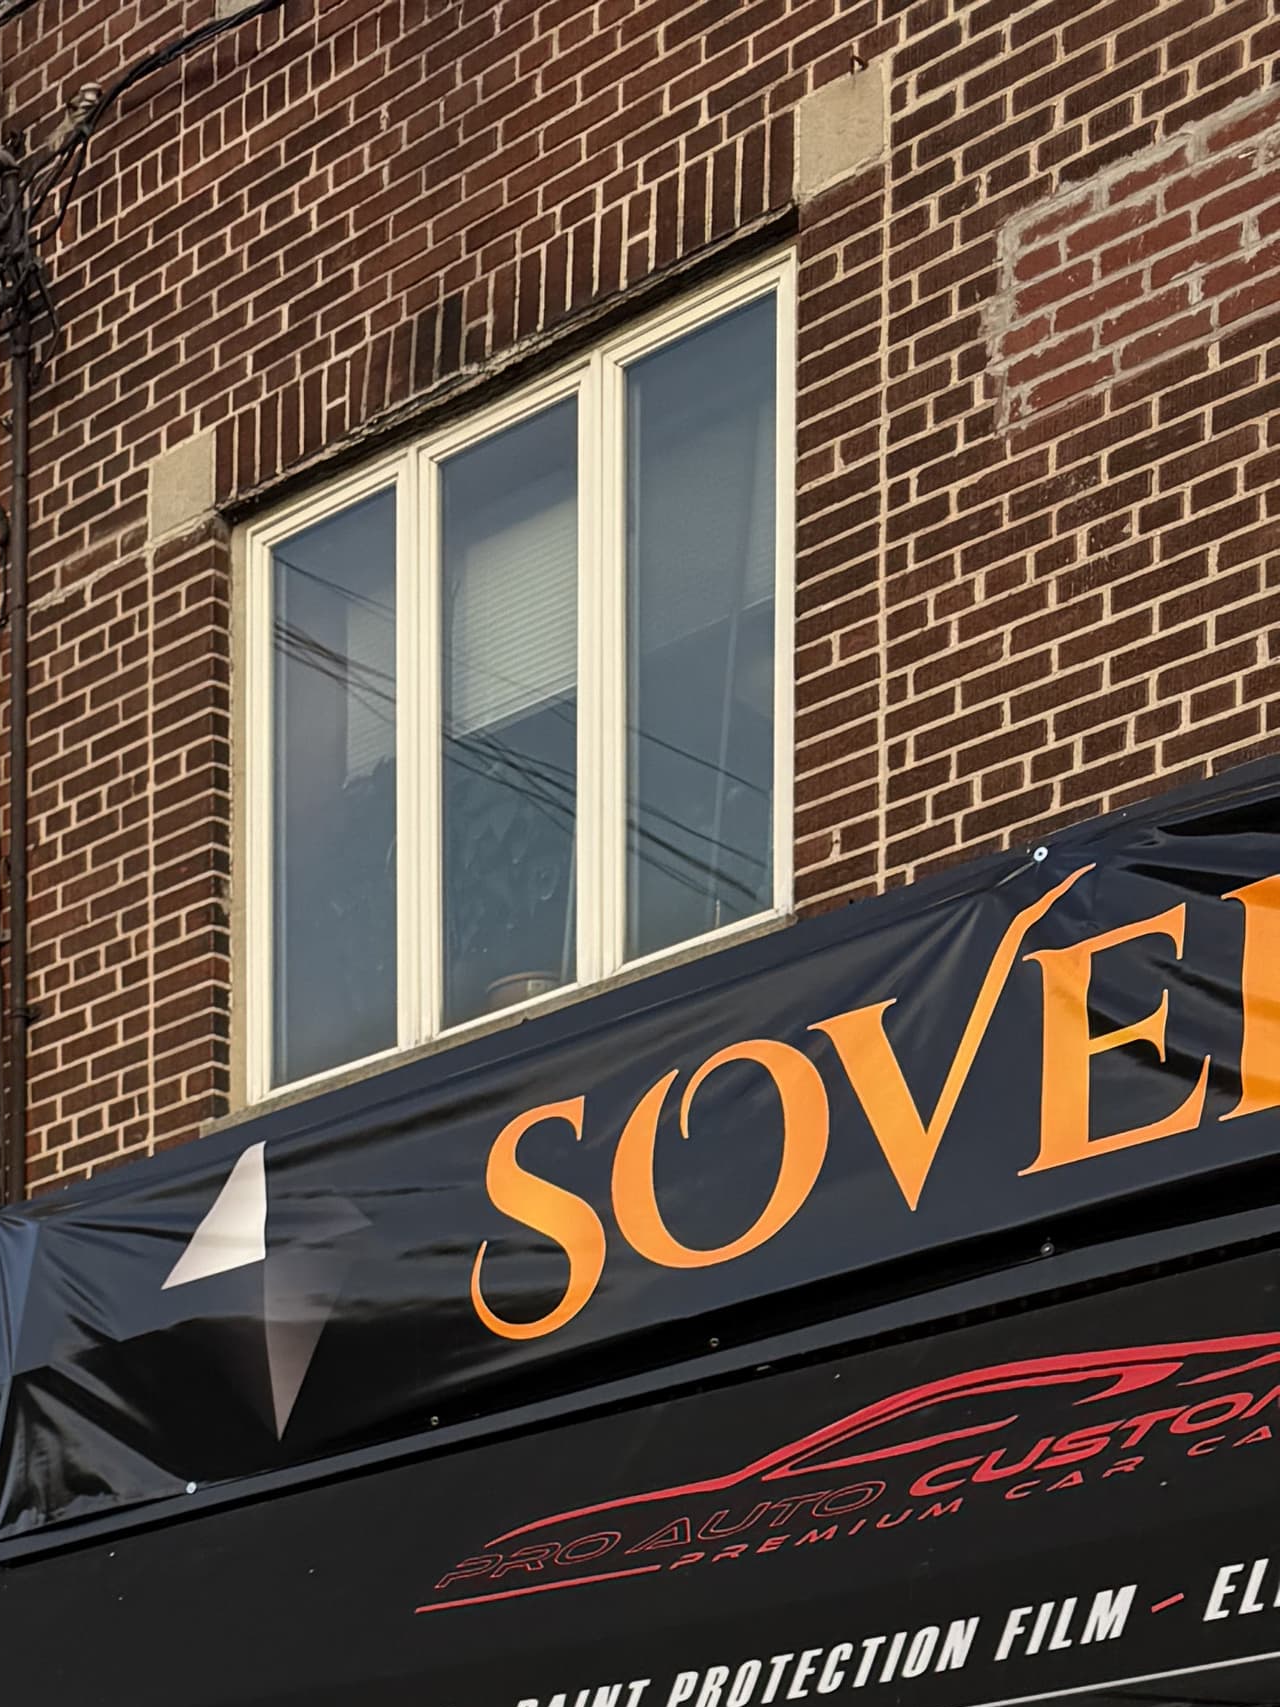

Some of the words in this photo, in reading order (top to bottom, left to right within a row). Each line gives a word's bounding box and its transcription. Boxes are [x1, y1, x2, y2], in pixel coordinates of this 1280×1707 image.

[434, 1531, 622, 1590] PRO
[625, 1480, 886, 1555] AUTO
[670, 1496, 964, 1570] PREMIUM
[1004, 1455, 1145, 1500] CAR
[992, 1582, 1138, 1664] FILM
[1203, 1558, 1280, 1622] EL
